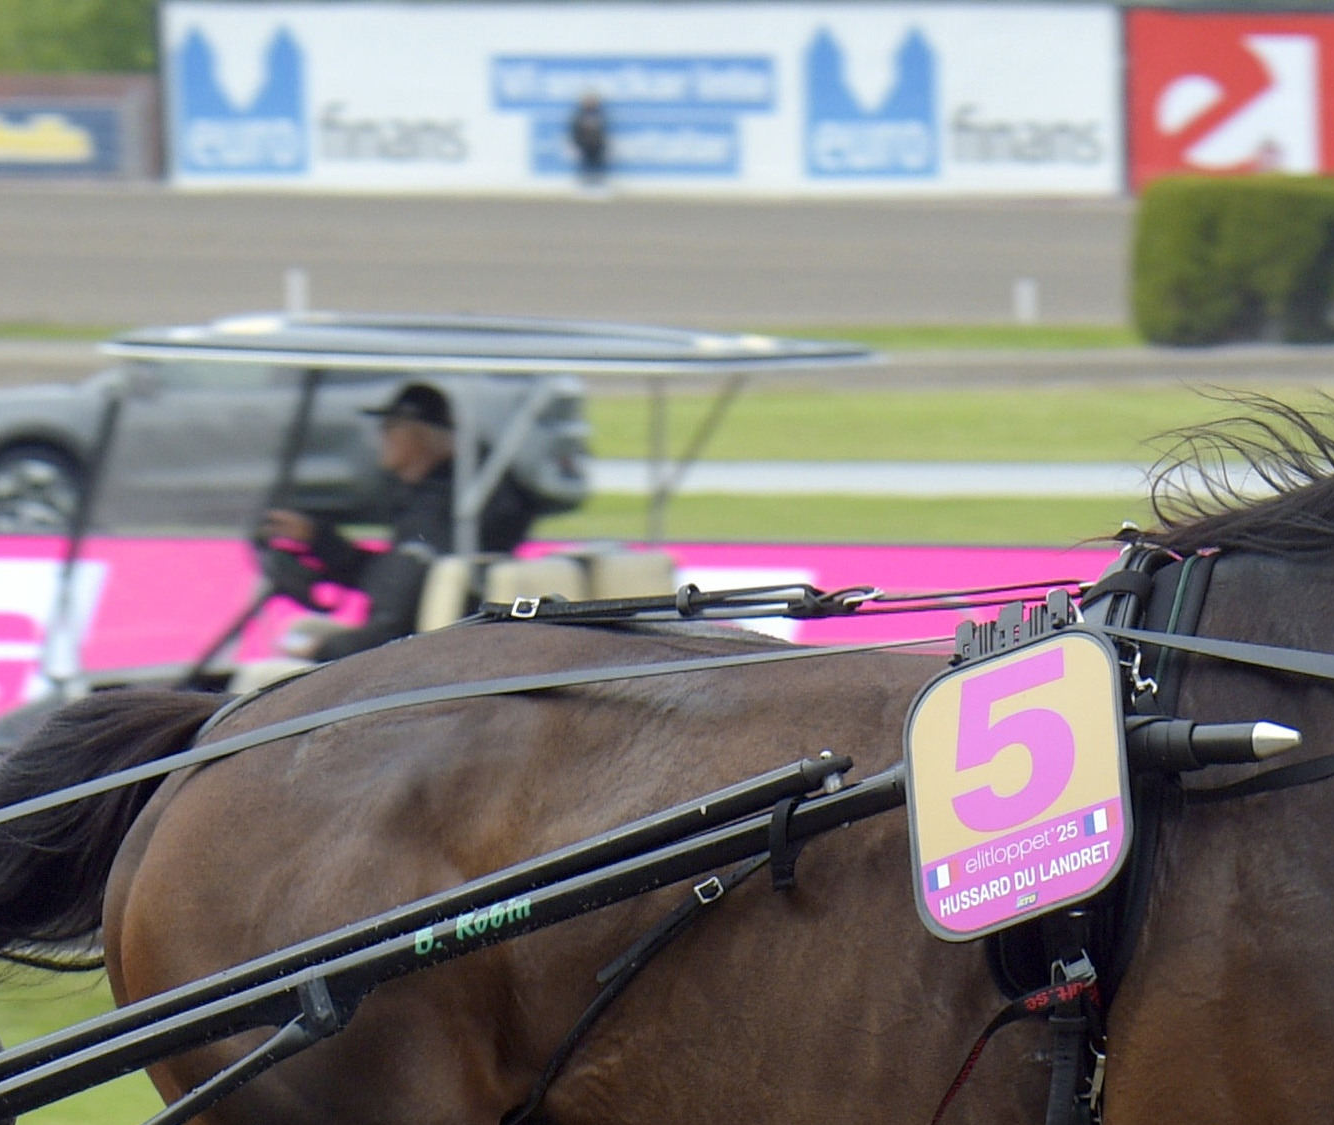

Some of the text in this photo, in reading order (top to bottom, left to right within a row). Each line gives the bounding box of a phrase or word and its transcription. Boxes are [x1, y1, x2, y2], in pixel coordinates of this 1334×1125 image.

[951, 646, 1076, 833] 5
[938, 841, 1111, 918] HUSSARD DU LANDRET
[965, 833, 1051, 873] elitloppet
